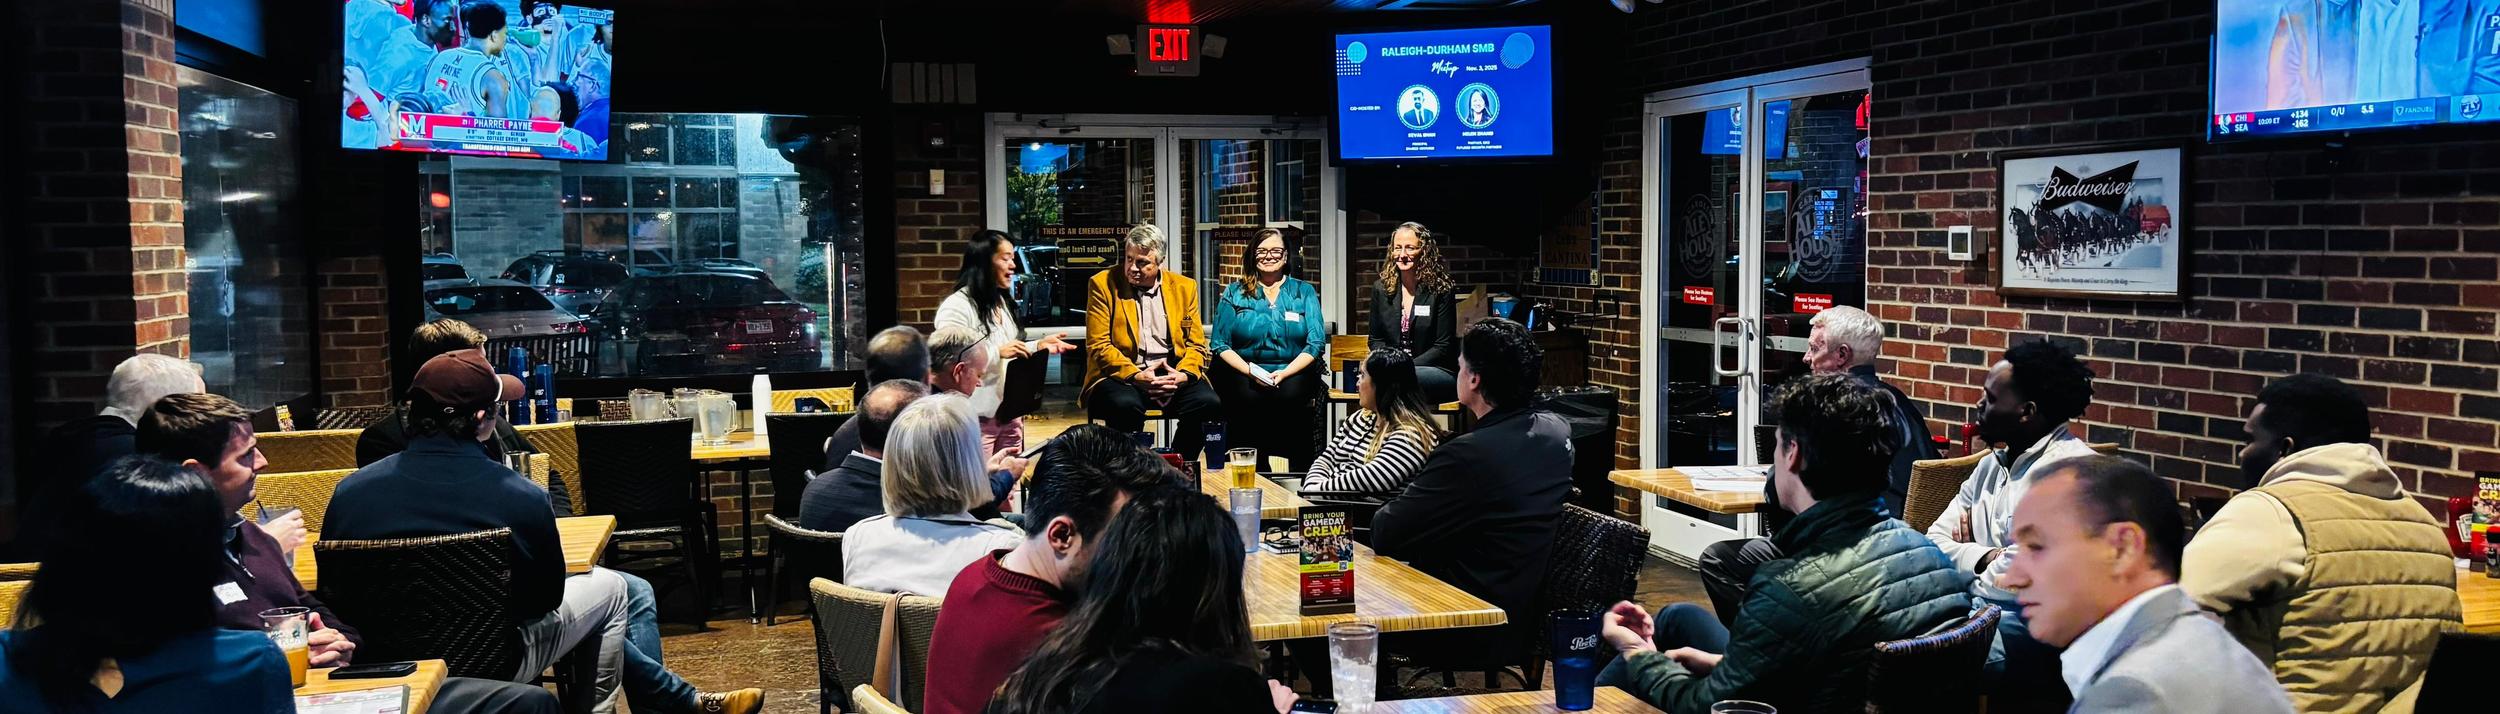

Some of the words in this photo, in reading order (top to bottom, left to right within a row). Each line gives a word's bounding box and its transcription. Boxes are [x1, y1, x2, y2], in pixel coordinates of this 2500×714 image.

[1149, 28, 1190, 61] EXIT
[1381, 44, 1471, 57] RALEIGH-DURHAM
[1472, 43, 1495, 53] SMB
[1431, 59, 1460, 78] Meetup
[2290, 109, 2309, 118] +134
[2330, 106, 2345, 116] O/U
[2361, 104, 2374, 114] 5.5
[2235, 113, 2247, 122] CHI
[474, 119, 506, 129] PHARREL
[508, 120, 532, 131] PAYNE
[2234, 123, 2248, 132] SEA
[2292, 119, 2309, 128] -162
[2035, 176, 2136, 201] Budweiser
[1043, 227, 1057, 235] THIS
[1058, 227, 1066, 235] IS
[1067, 227, 1077, 235] AN
[1078, 227, 1115, 235] EMERGENCY
[1808, 303, 1824, 311] Seating
[1303, 517, 1345, 527] GAMEDAY
[1303, 524, 1346, 538] CREW!
